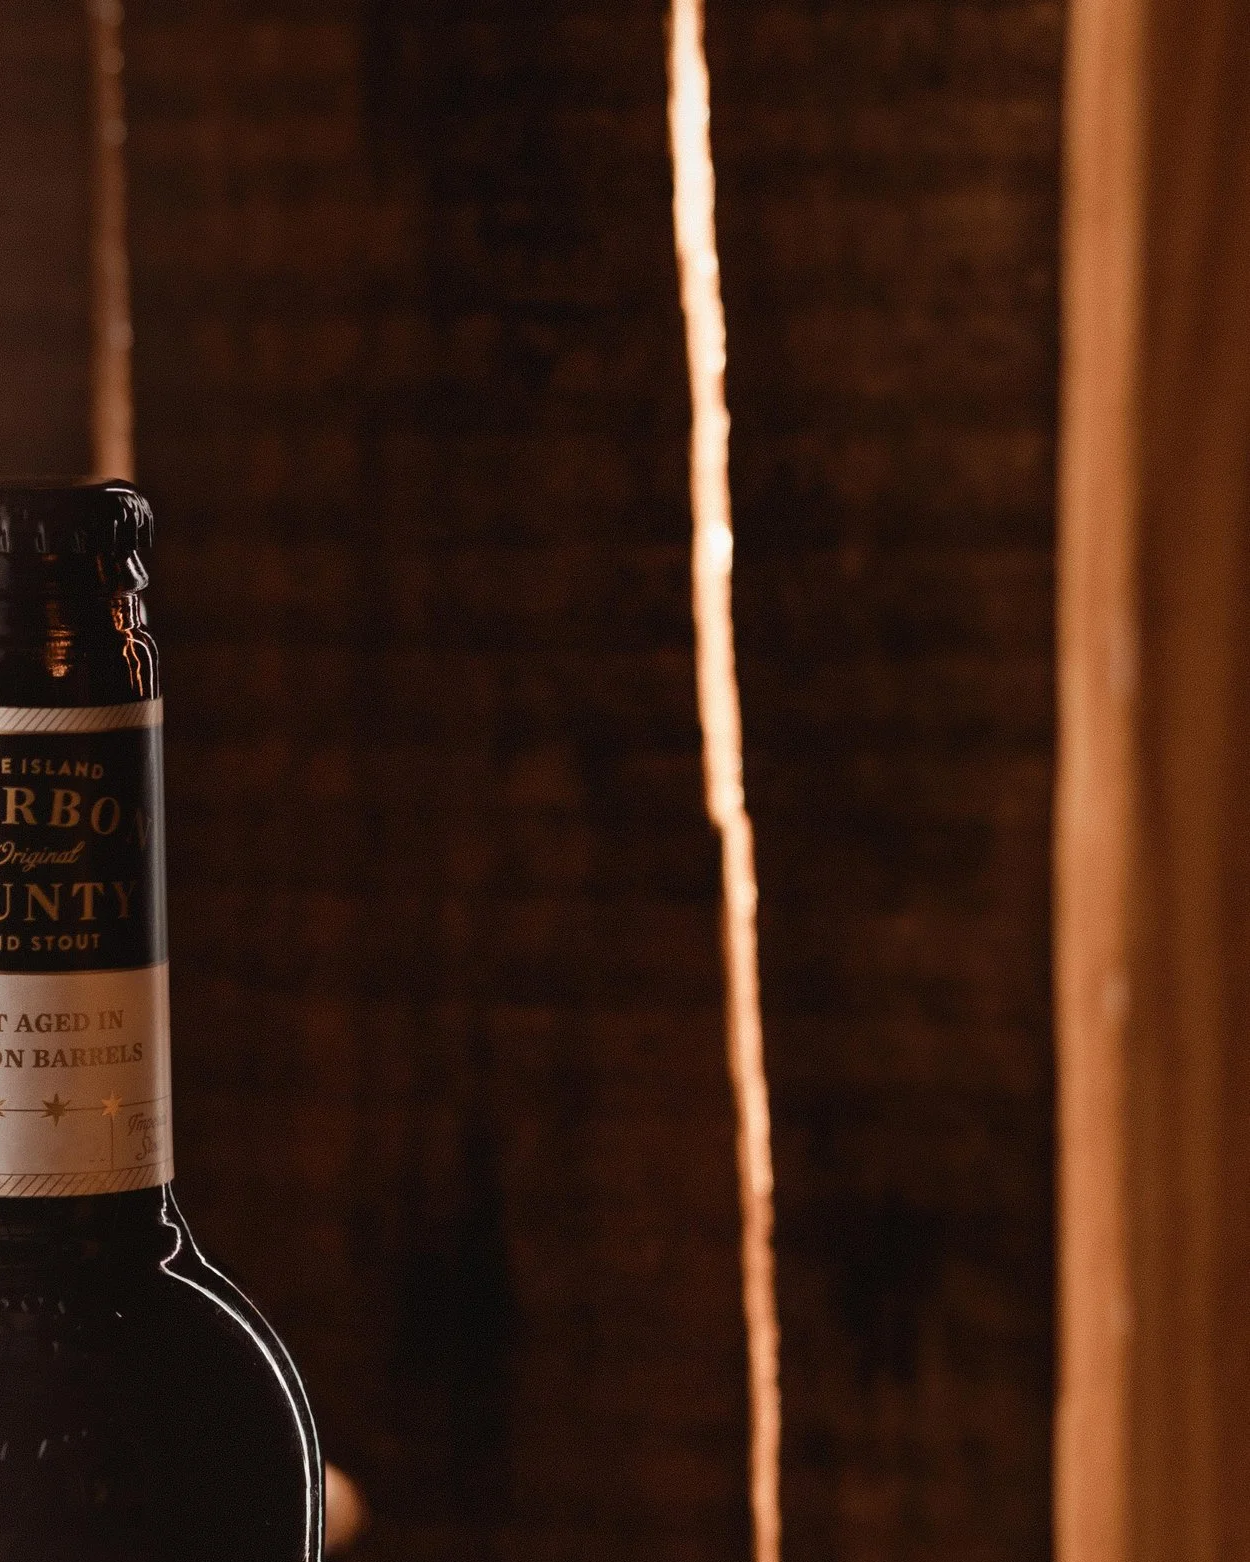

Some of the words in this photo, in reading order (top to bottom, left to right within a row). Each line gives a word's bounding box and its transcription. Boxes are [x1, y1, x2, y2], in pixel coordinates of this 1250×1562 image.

[21, 758, 105, 780] ISLAND
[31, 932, 101, 951] STOUT
[13, 1012, 91, 1034] AGED
[98, 1009, 124, 1030] IN
[32, 1042, 143, 1069] BARRELS
